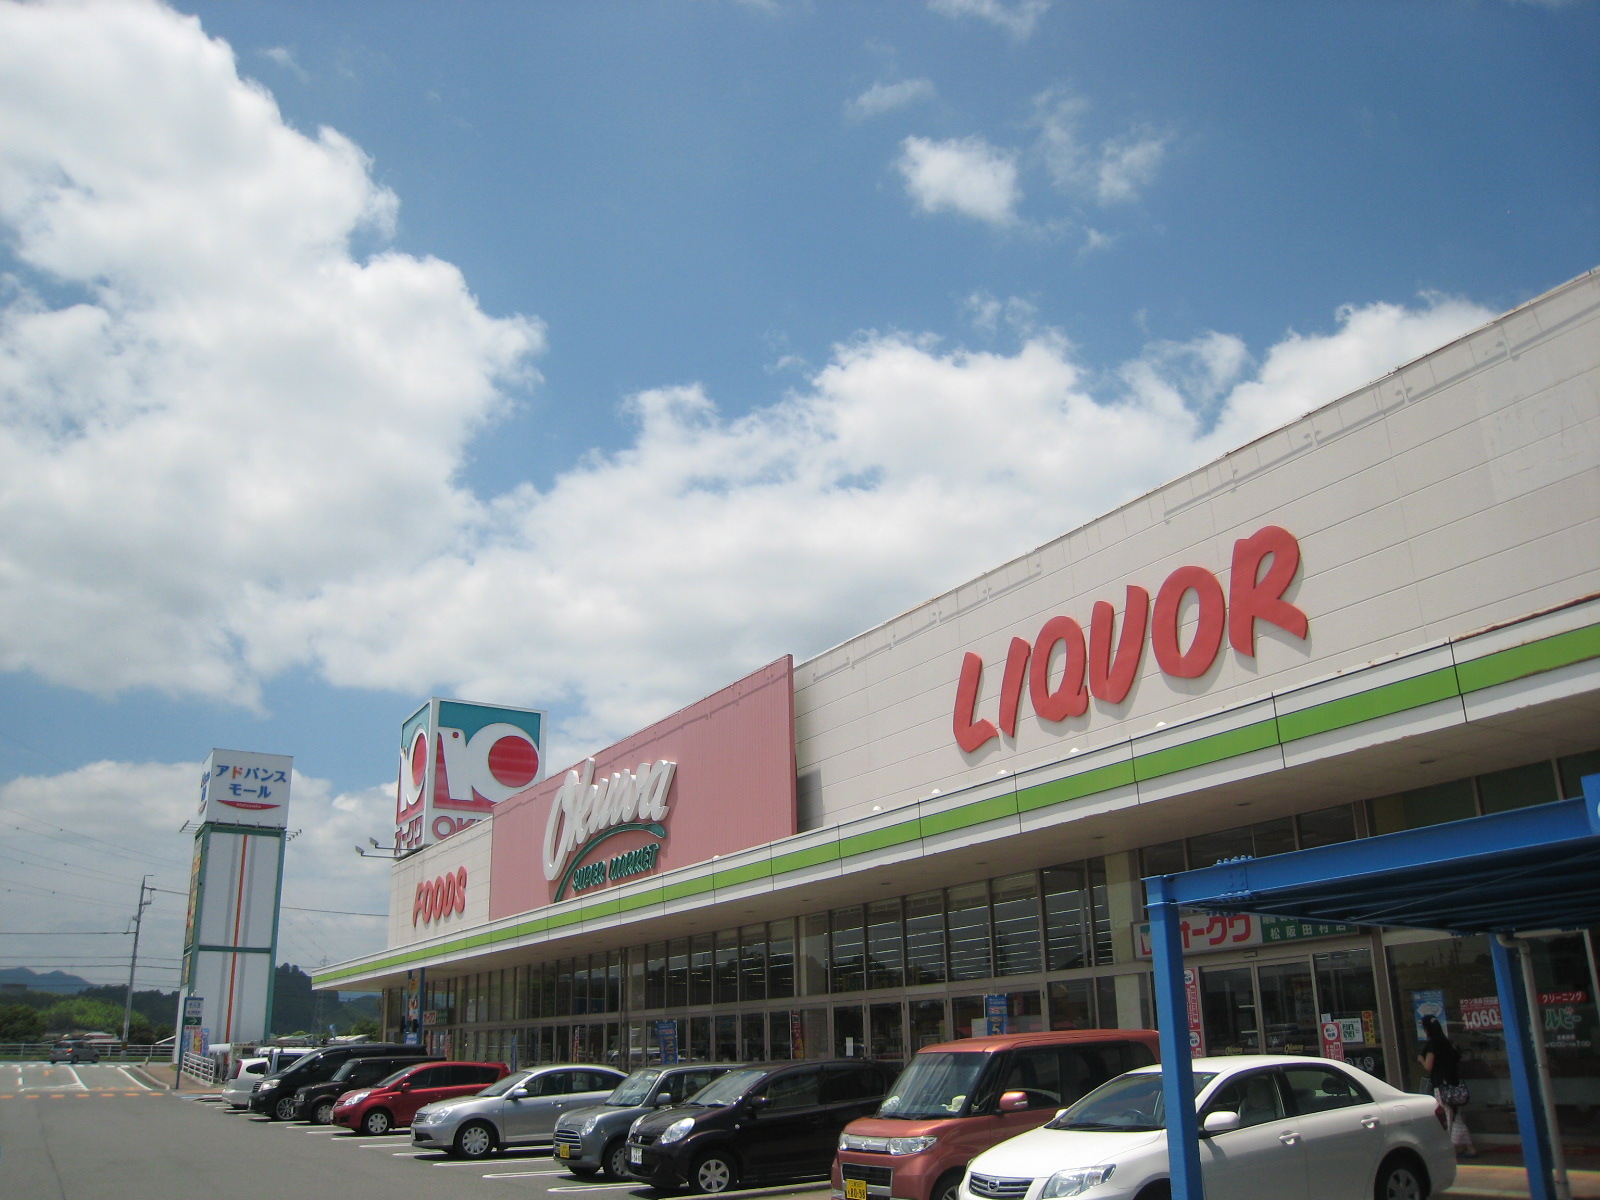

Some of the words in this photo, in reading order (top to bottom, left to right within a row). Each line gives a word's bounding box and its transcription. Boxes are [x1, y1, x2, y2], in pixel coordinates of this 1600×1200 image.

[953, 525, 1308, 753] LIQUOR
[216, 764, 287, 783] アドバンス
[229, 783, 272, 799] モール
[543, 757, 677, 880] Okuwa
[572, 860, 606, 892] SUPER
[609, 843, 660, 880] MARKET
[412, 865, 468, 928] FOODS
[1542, 991, 1582, 1004] クリーニング
[1545, 1006, 1582, 1031] ルビー
